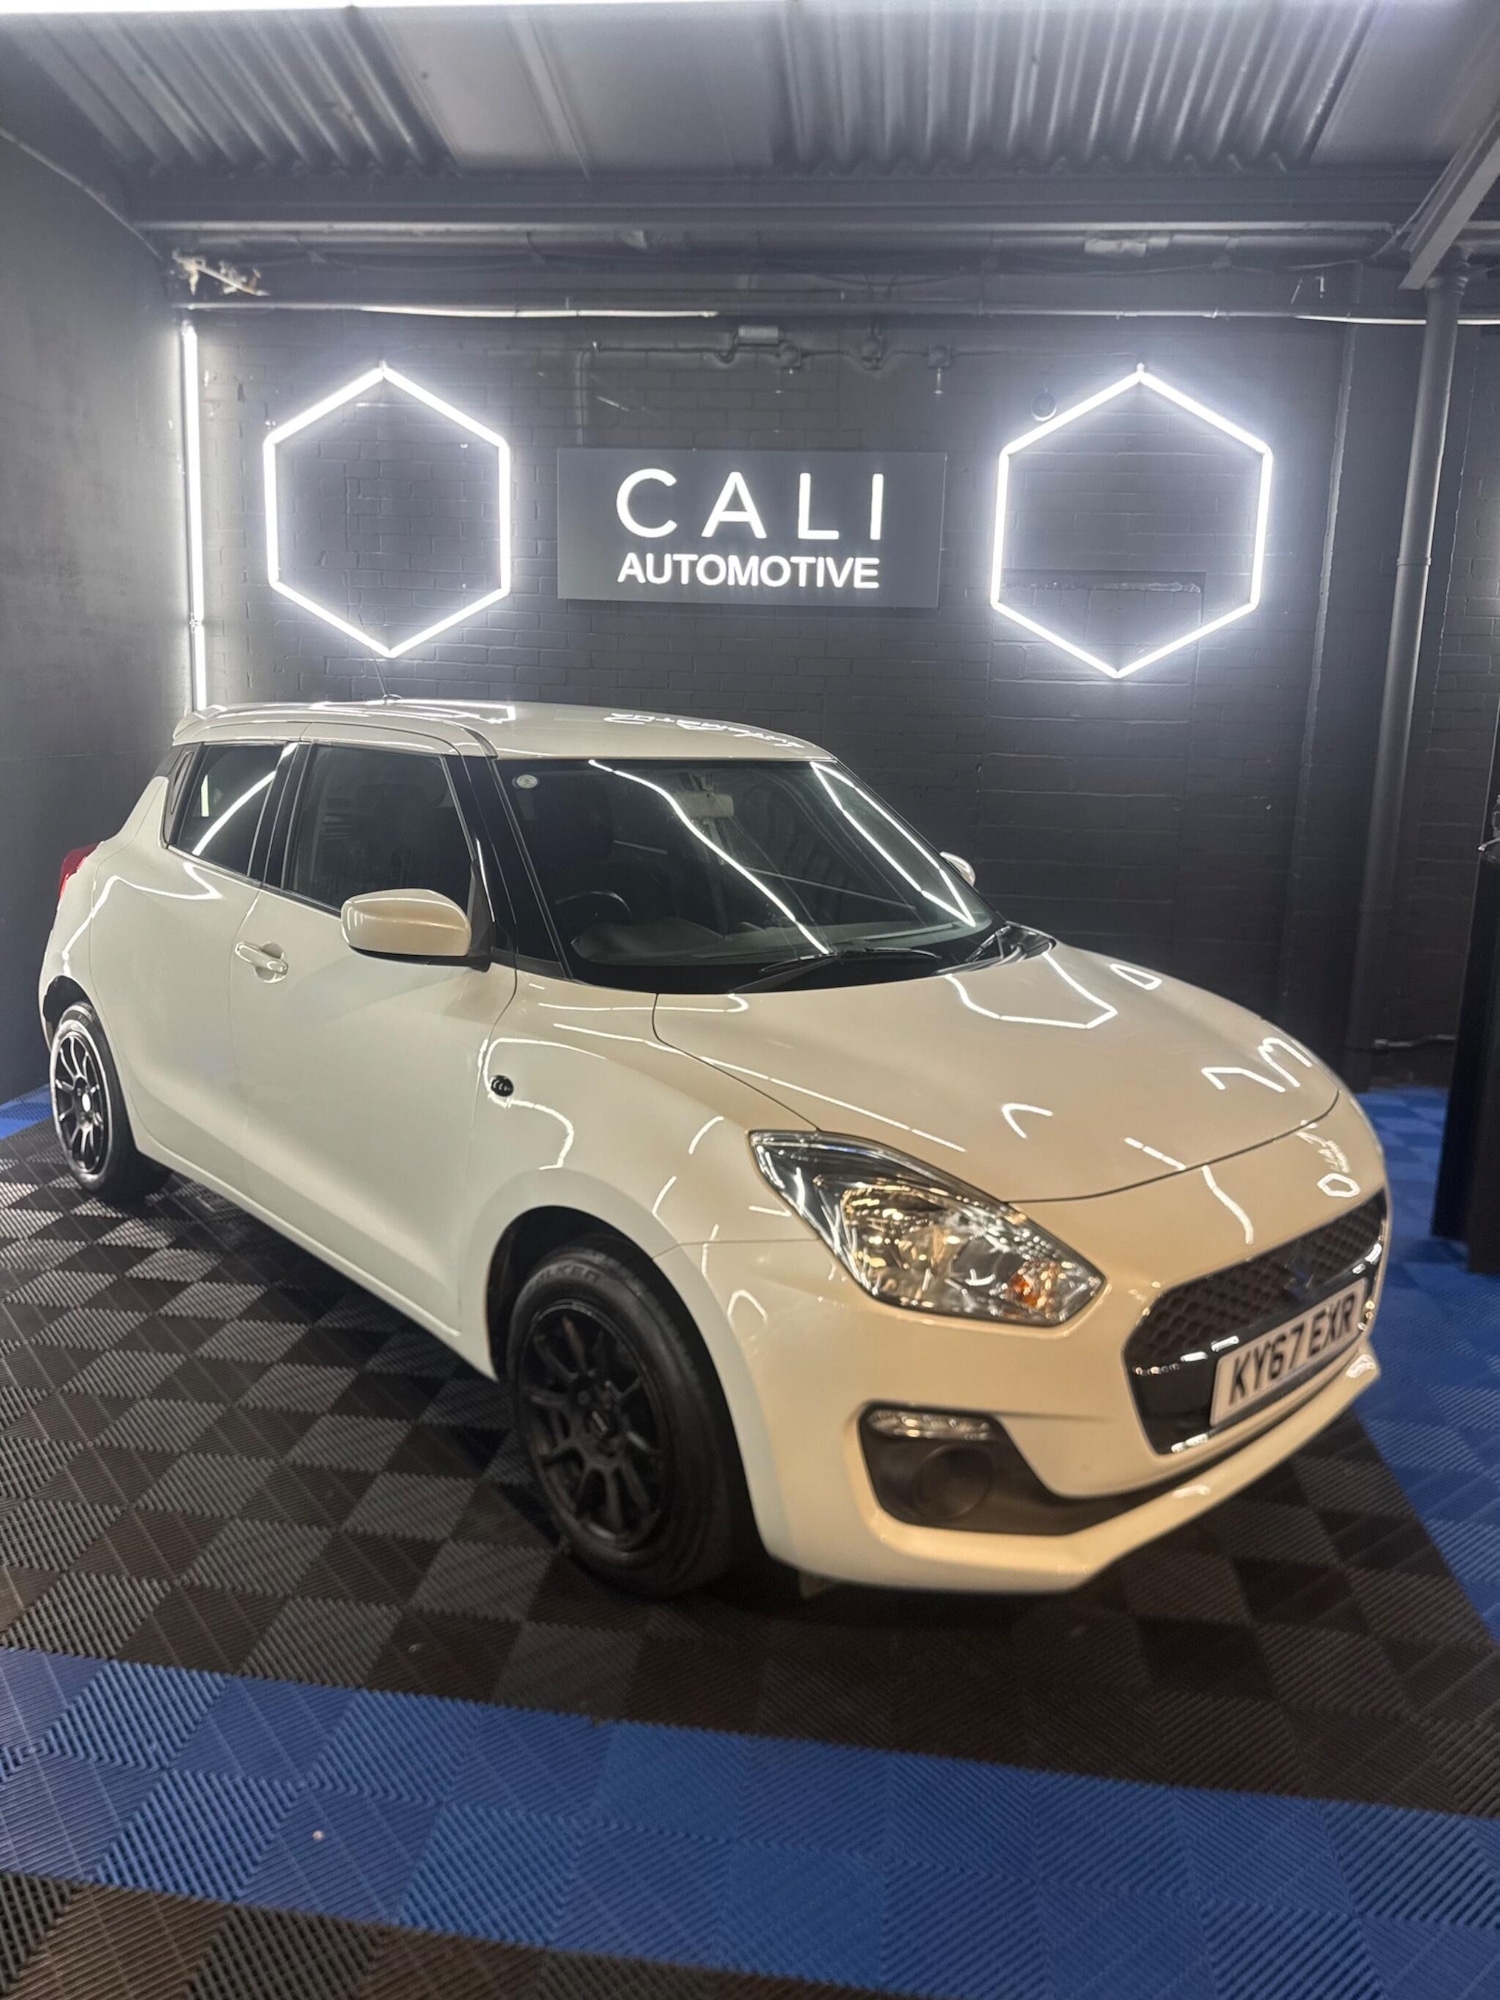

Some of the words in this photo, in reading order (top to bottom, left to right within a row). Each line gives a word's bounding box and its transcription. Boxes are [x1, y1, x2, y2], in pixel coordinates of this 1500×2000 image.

[616, 468, 884, 540] CALI
[617, 552, 880, 589] AUTOMOTIVE
[1228, 1320, 1305, 1406] KY67
[1306, 1292, 1356, 1358] EXR
